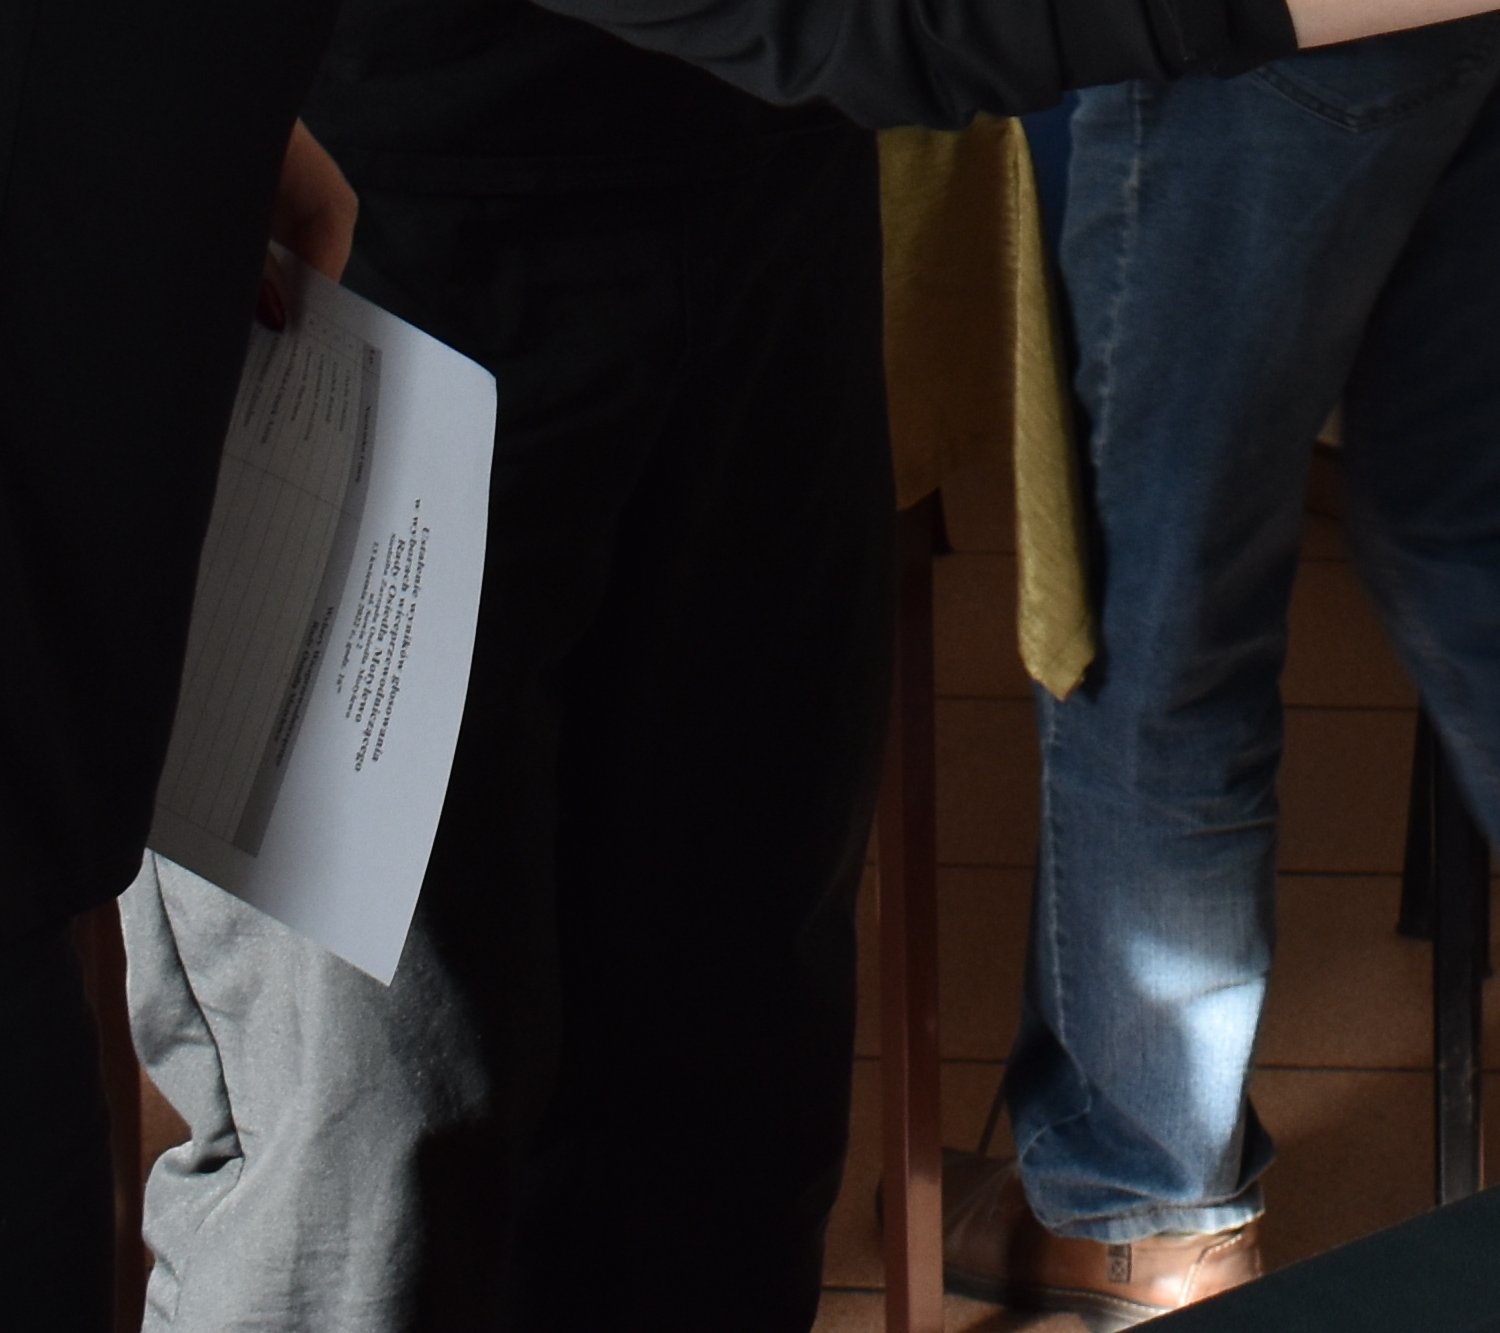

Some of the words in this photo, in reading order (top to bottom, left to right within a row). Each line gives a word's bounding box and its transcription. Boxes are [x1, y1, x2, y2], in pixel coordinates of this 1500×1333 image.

[391, 539, 406, 577] Rady
[400, 516, 419, 592] wyborach
[411, 527, 430, 598] Ustalenie
[376, 584, 395, 641] Osiedla
[397, 602, 417, 670] wyników
[354, 648, 382, 723] Motylewo
[371, 675, 399, 763] głosowania
